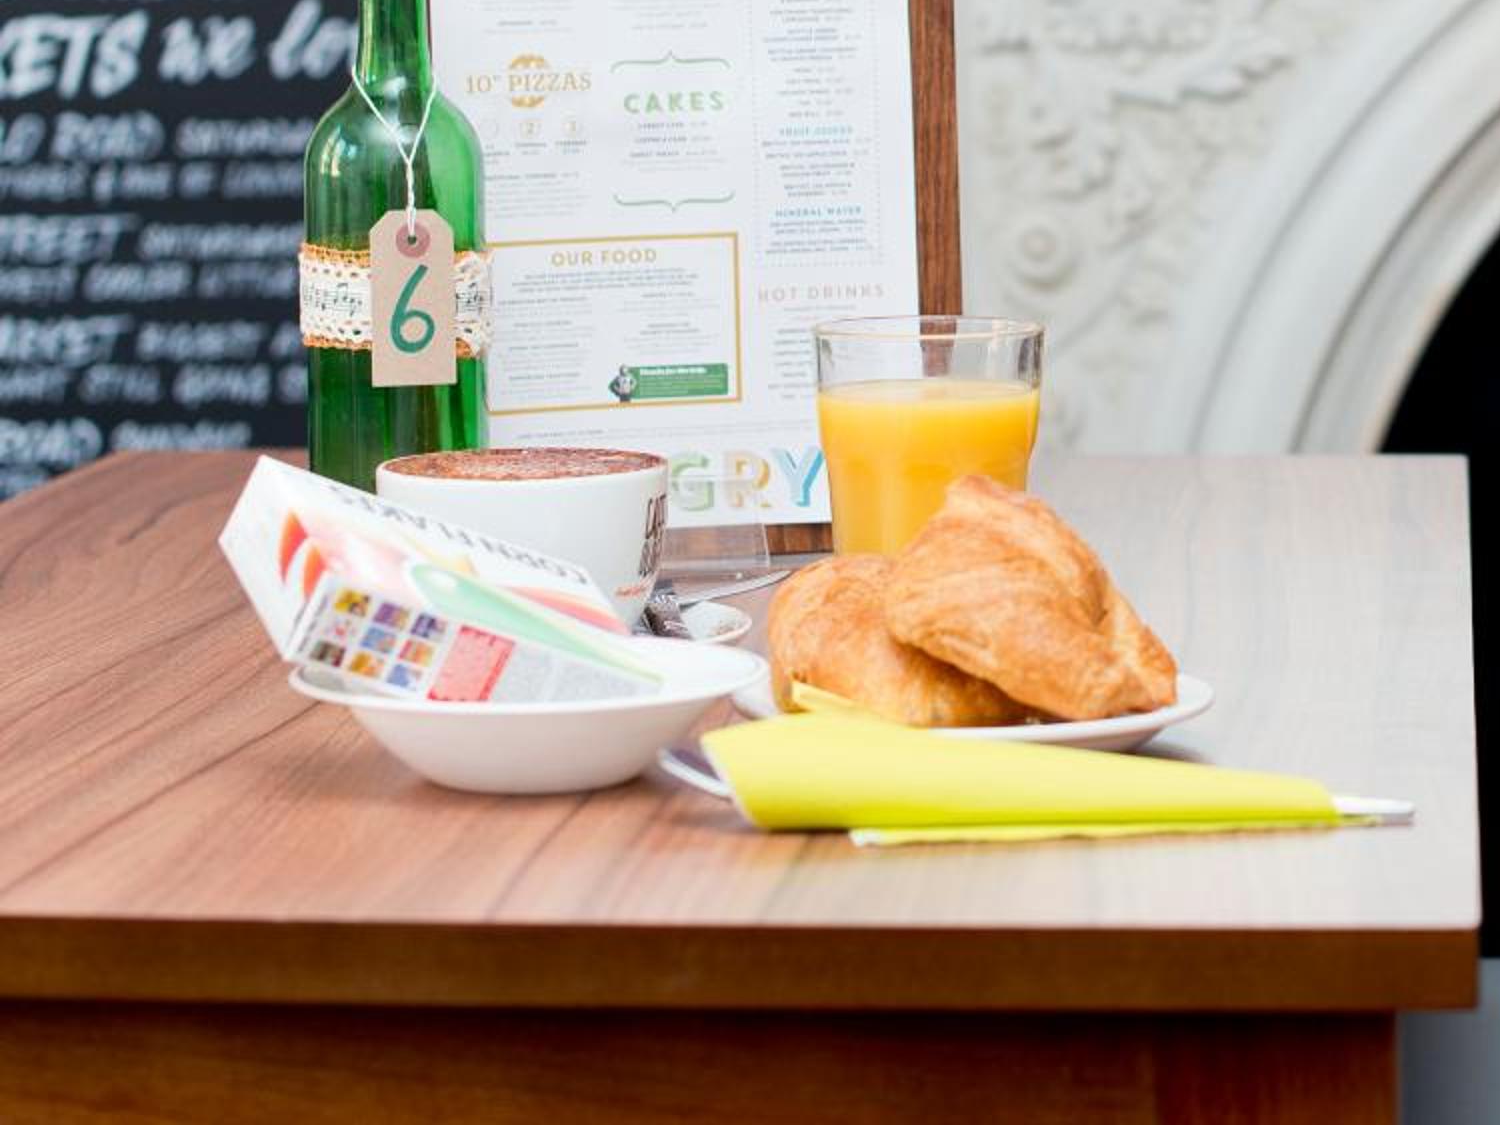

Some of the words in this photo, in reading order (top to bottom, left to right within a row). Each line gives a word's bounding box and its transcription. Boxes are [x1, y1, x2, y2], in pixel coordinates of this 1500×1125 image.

[0, 9, 149, 98] ETS
[508, 71, 593, 92] PIZZAS
[623, 91, 726, 115] CAKES
[551, 250, 594, 267] OUR
[601, 248, 657, 265] FOOD
[758, 285, 802, 305] HOT
[808, 282, 886, 301] DRINKS
[389, 262, 437, 355] 6
[671, 446, 826, 512] GRY
